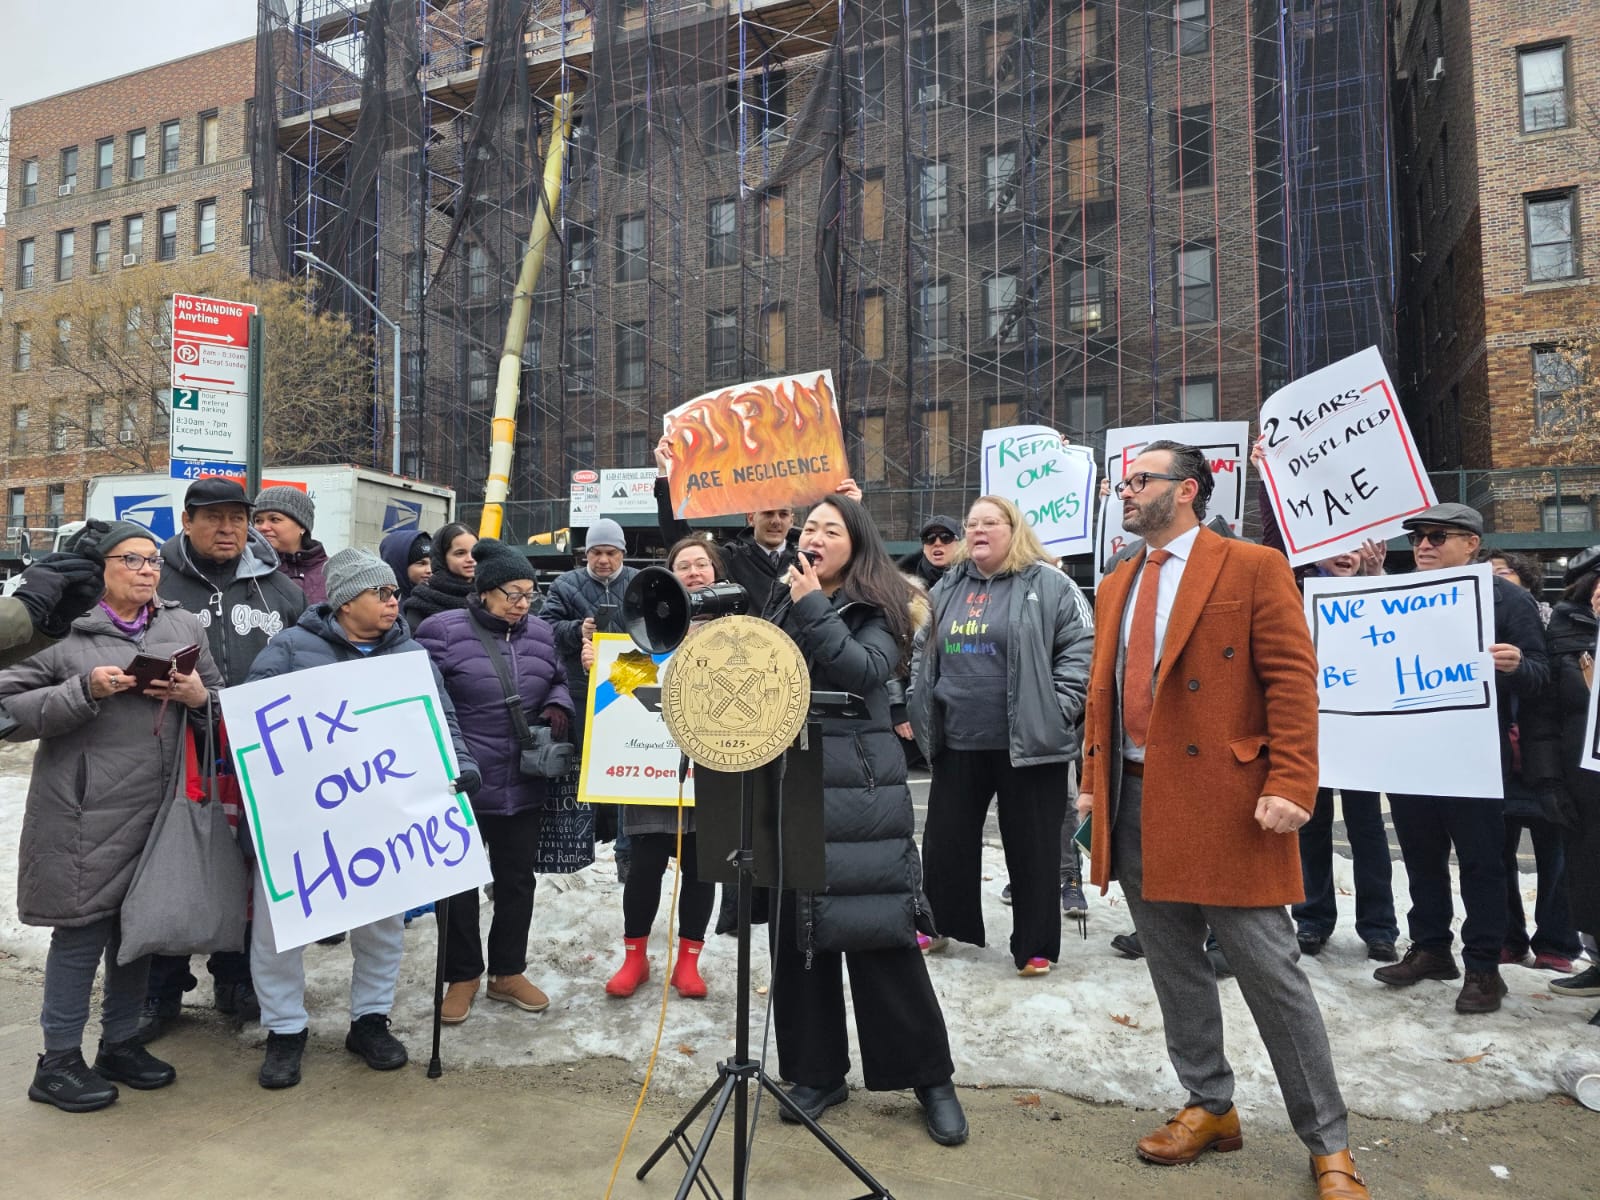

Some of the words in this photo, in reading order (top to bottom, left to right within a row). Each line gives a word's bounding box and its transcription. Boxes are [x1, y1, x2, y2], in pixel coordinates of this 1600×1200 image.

[178, 299, 193, 310] NO
[195, 301, 243, 317] STANDING
[178, 310, 220, 325] Anytime
[202, 358, 223, 367] Except
[225, 360, 247, 370] Sunday
[178, 389, 193, 409] 2
[201, 399, 229, 408] metered
[201, 406, 226, 414] parking
[1264, 416, 1290, 449] 2
[1289, 388, 1361, 432] YEARS
[176, 416, 205, 426] 8:30am
[213, 420, 228, 429] 7pm
[176, 426, 202, 435] Except
[204, 427, 232, 439] Sunday
[1288, 408, 1391, 477] DISPLACED
[732, 455, 831, 485] NEGLIGENCE
[1016, 459, 1064, 489] OUR
[1015, 492, 1080, 527] OMES
[1320, 599, 1367, 625] We
[1381, 586, 1464, 615] want
[951, 620, 989, 636] better
[1360, 624, 1396, 647] to
[945, 637, 997, 656] humans
[1323, 666, 1360, 688] BE
[689, 737, 749, 764] CIVITATIS
[750, 734, 784, 760] NOVI
[720, 740, 746, 748] 1625
[315, 749, 418, 809] OUR
[606, 765, 640, 777] 4872
[643, 765, 677, 779] Open
[293, 806, 471, 918] Homes
